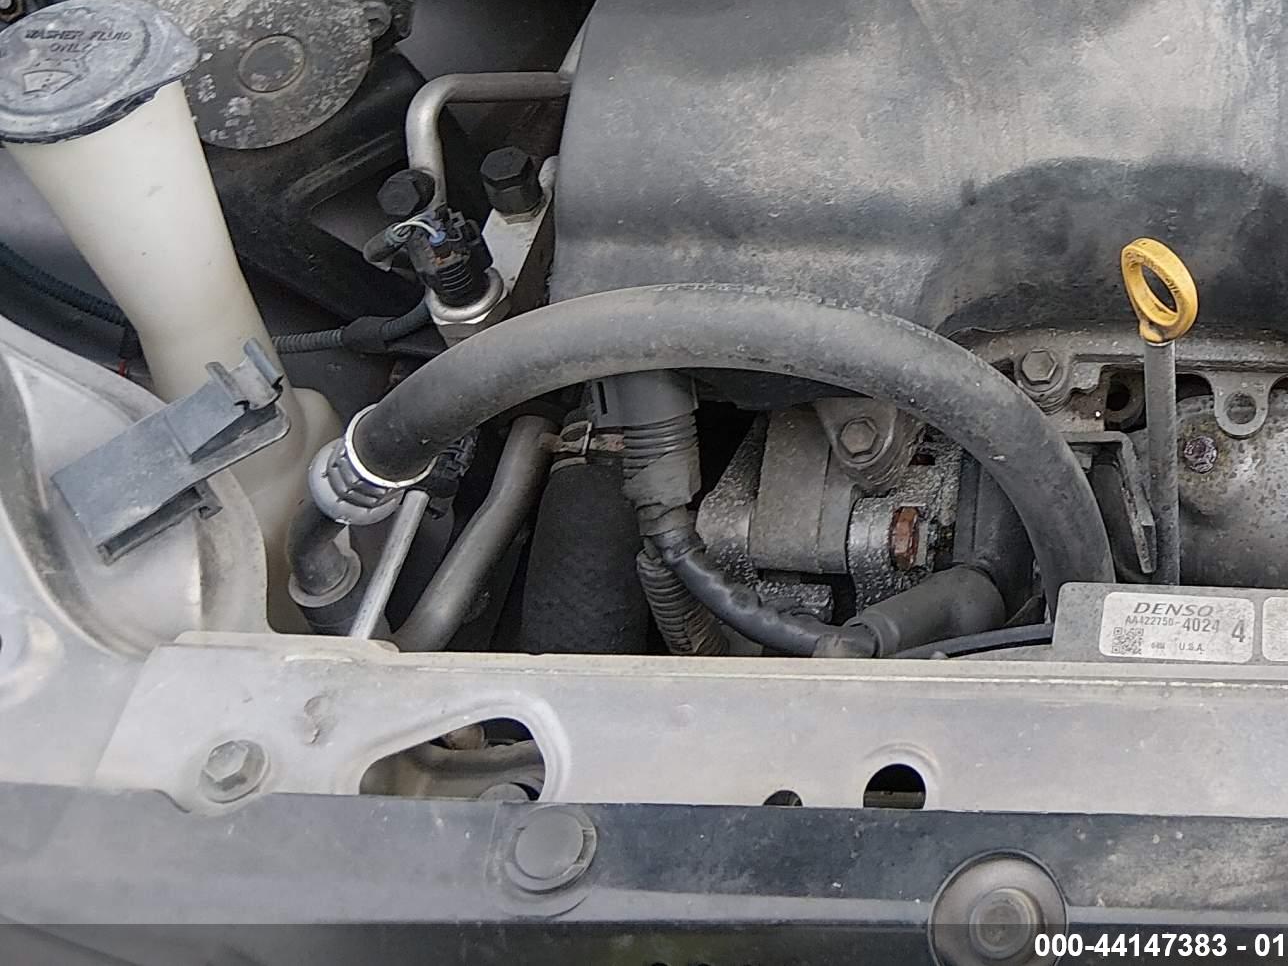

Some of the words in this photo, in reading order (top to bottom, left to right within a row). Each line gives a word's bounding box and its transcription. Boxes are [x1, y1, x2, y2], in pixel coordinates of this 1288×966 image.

[24, 29, 85, 40] WASHER
[89, 30, 134, 41] FLUID
[49, 42, 92, 53] ONLY
[1133, 602, 1214, 617] DENSO
[1230, 619, 1247, 643] 4
